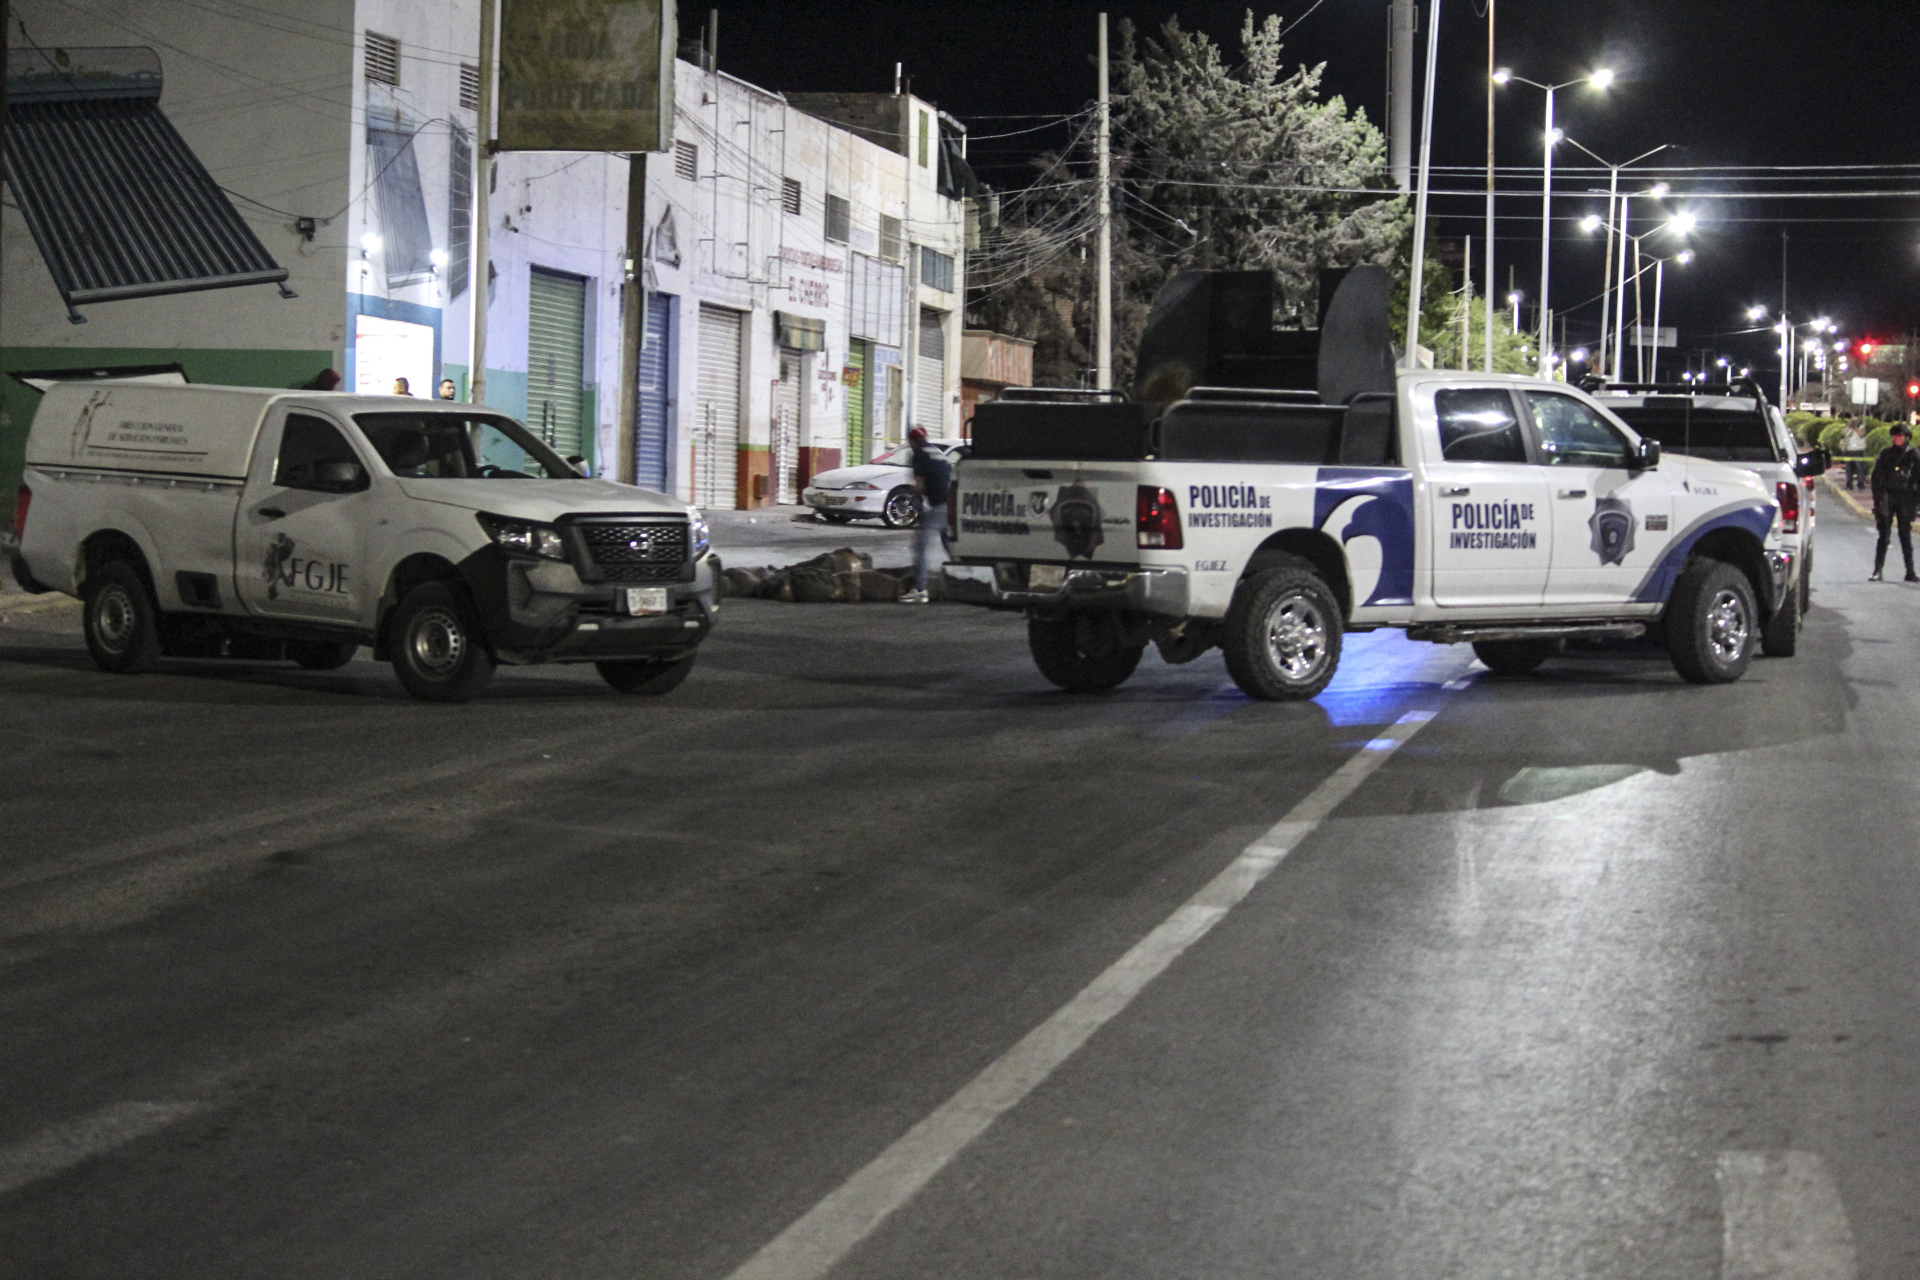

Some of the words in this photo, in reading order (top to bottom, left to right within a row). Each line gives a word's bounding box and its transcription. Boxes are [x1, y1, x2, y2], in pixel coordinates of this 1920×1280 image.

[963, 490, 1015, 517] POLICÍA
[1189, 481, 1257, 509] POLICÍA
[1259, 495, 1271, 509] DE
[1188, 510, 1273, 528] INVESTIGACIÓN
[1452, 498, 1521, 529] POLICÍA
[1520, 503, 1535, 520] DE
[1450, 529, 1536, 549] INVESTIGACIÓN
[290, 557, 350, 594] FGJE
